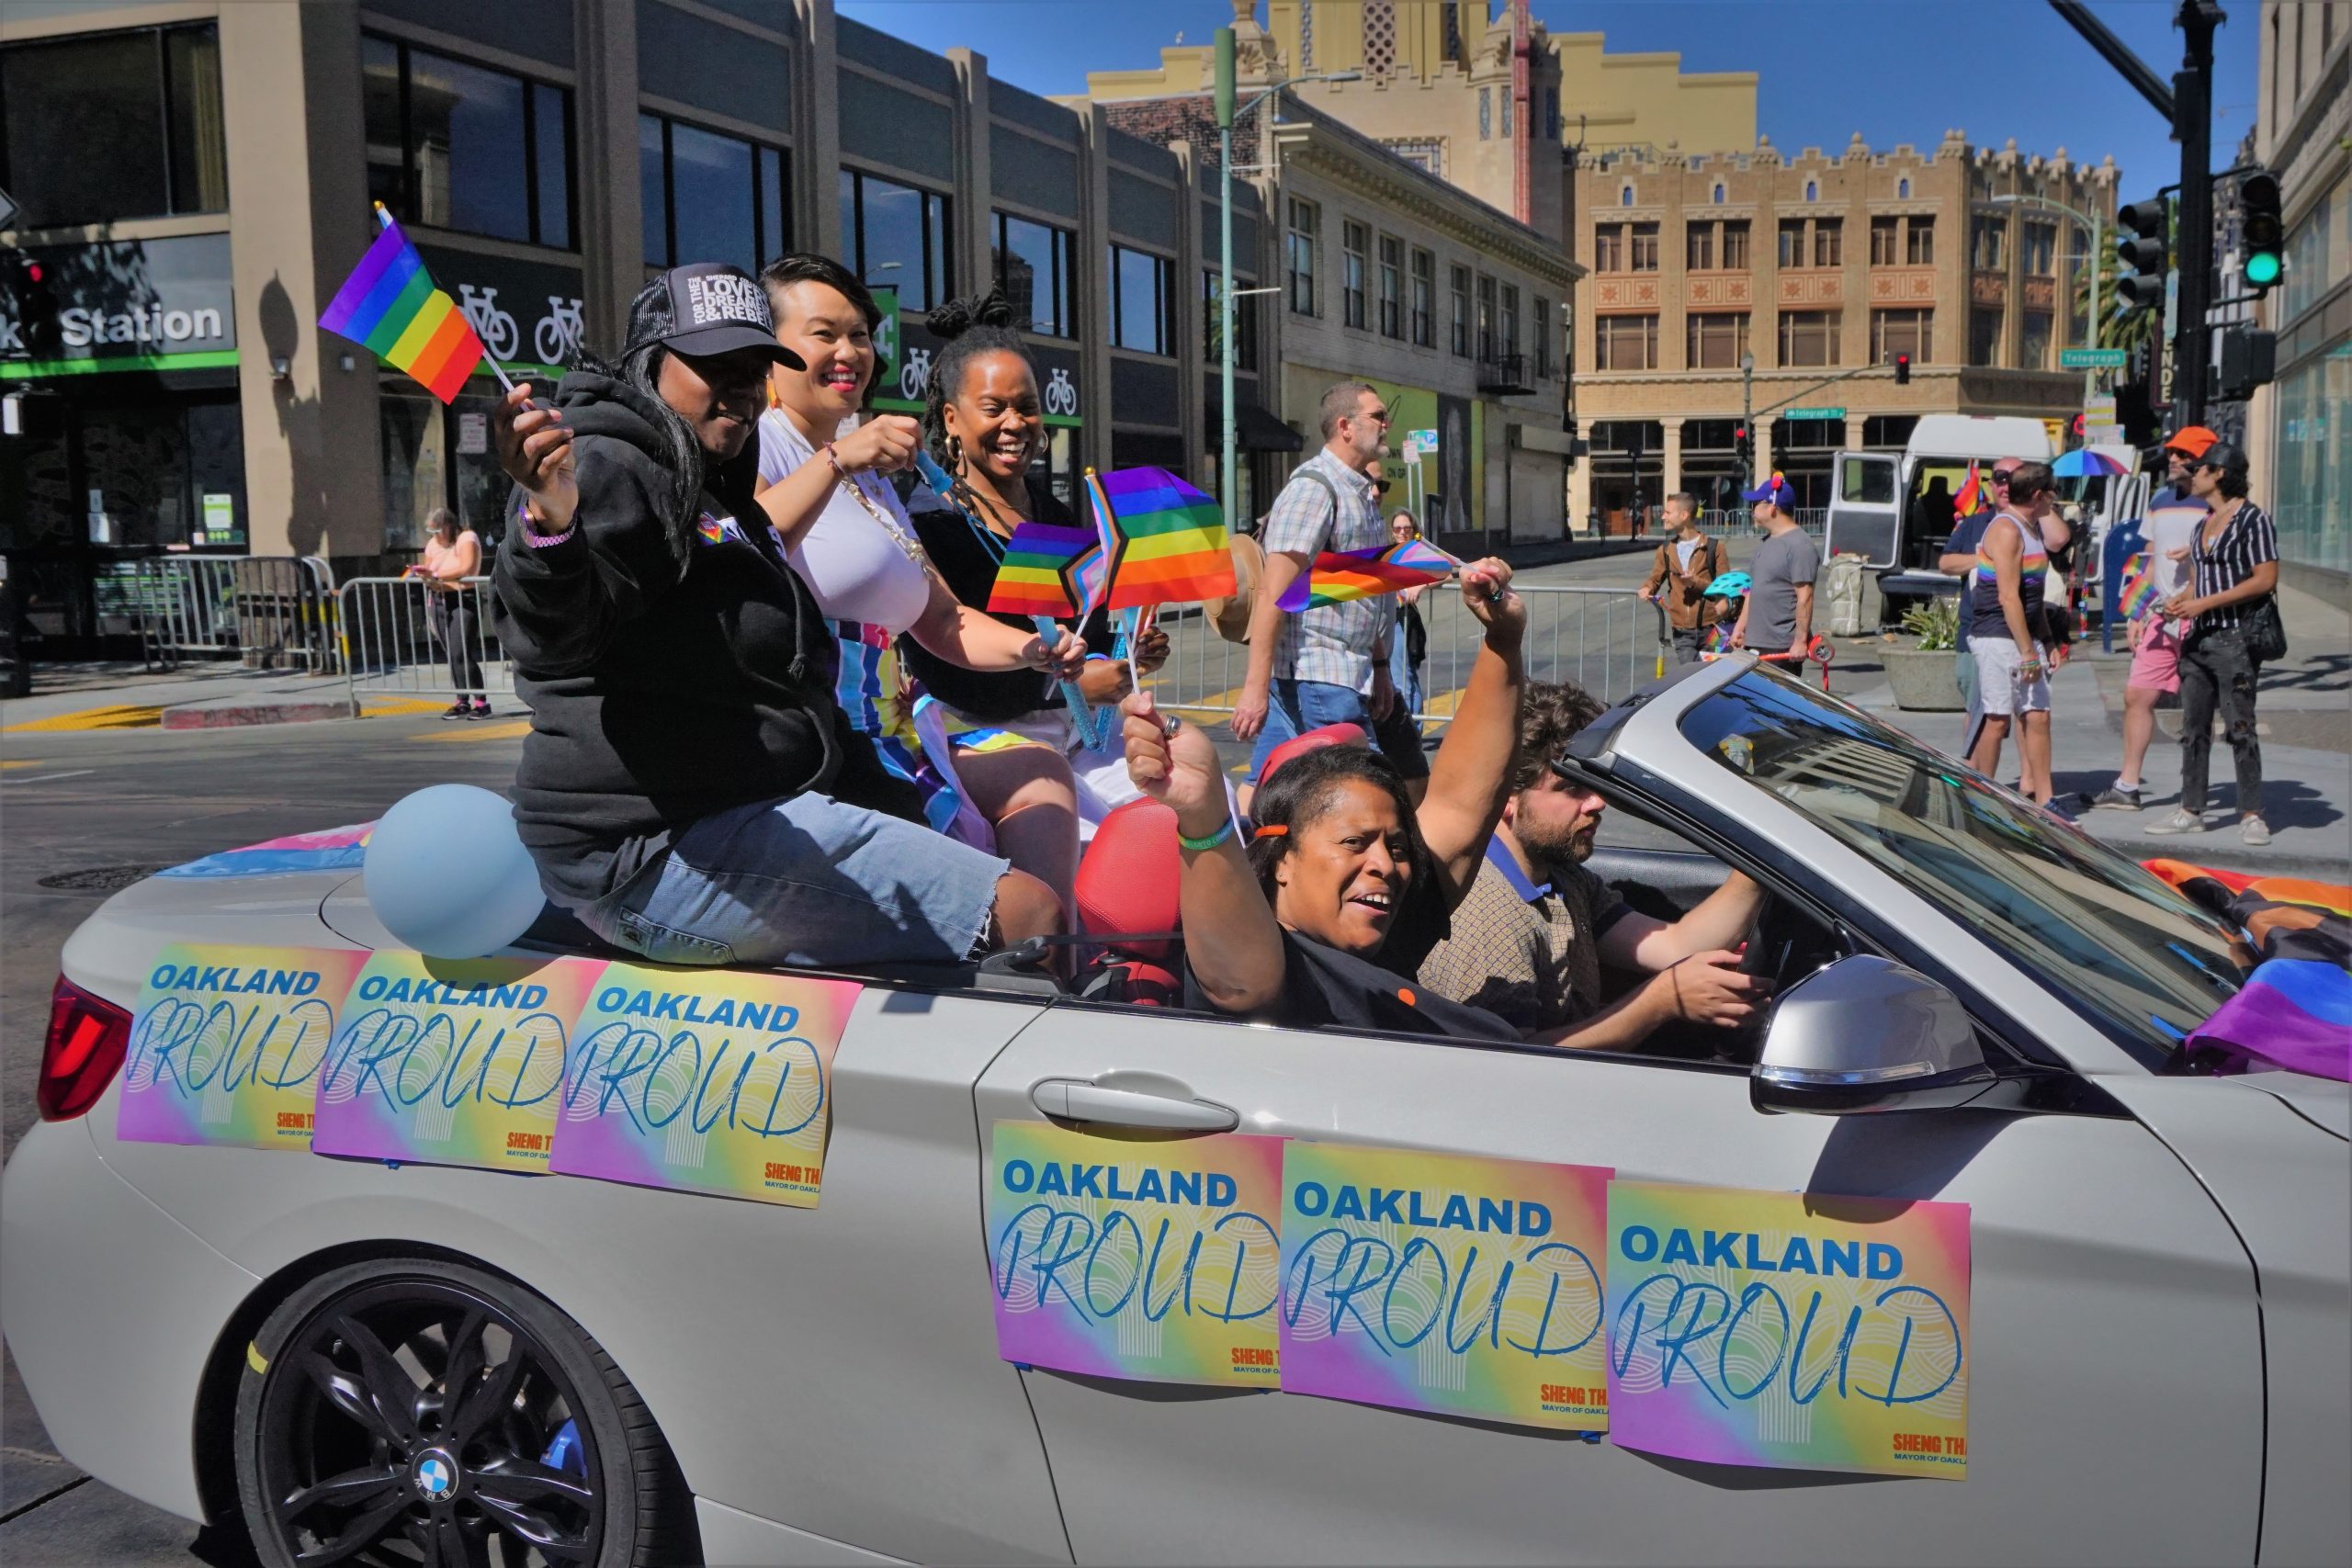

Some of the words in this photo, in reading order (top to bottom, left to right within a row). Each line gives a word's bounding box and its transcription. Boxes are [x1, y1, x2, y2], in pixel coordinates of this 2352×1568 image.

[689, 278, 702, 303] THE
[61, 302, 222, 347] Station
[693, 303, 706, 324] FOR
[706, 308, 721, 321] &
[2064, 353, 2120, 366] Telegraph
[151, 964, 321, 996] OAKLAND
[358, 976, 548, 1010] OAKLAND
[597, 987, 800, 1032] OAKLAND
[126, 997, 334, 1100] PROUD
[322, 1008, 568, 1114] PROUD
[565, 1021, 824, 1139] PROUD
[277, 1112, 305, 1129] SHENG
[506, 1132, 543, 1150] SHENG
[764, 1162, 802, 1182] SHENG
[1003, 1159, 1238, 1208] OAKLAND
[764, 1181, 788, 1190] MAYOR
[1294, 1181, 1553, 1237] OAKLAND
[1620, 1224, 1904, 1281] OAKLAND
[997, 1203, 1280, 1328] PROUD
[1284, 1228, 1605, 1359] PROUD
[1611, 1273, 1962, 1411] PROUD
[1231, 1347, 1273, 1366] SHENG
[1541, 1383, 1586, 1404] SHENG
[1589, 1388, 1609, 1406] TH
[1542, 1404, 1570, 1413] MAYOR
[1893, 1433, 1941, 1453] SHENG
[1944, 1437, 1967, 1456] TH
[1894, 1453, 1926, 1461] MAYOR
[413, 1478, 451, 1500] BMW
